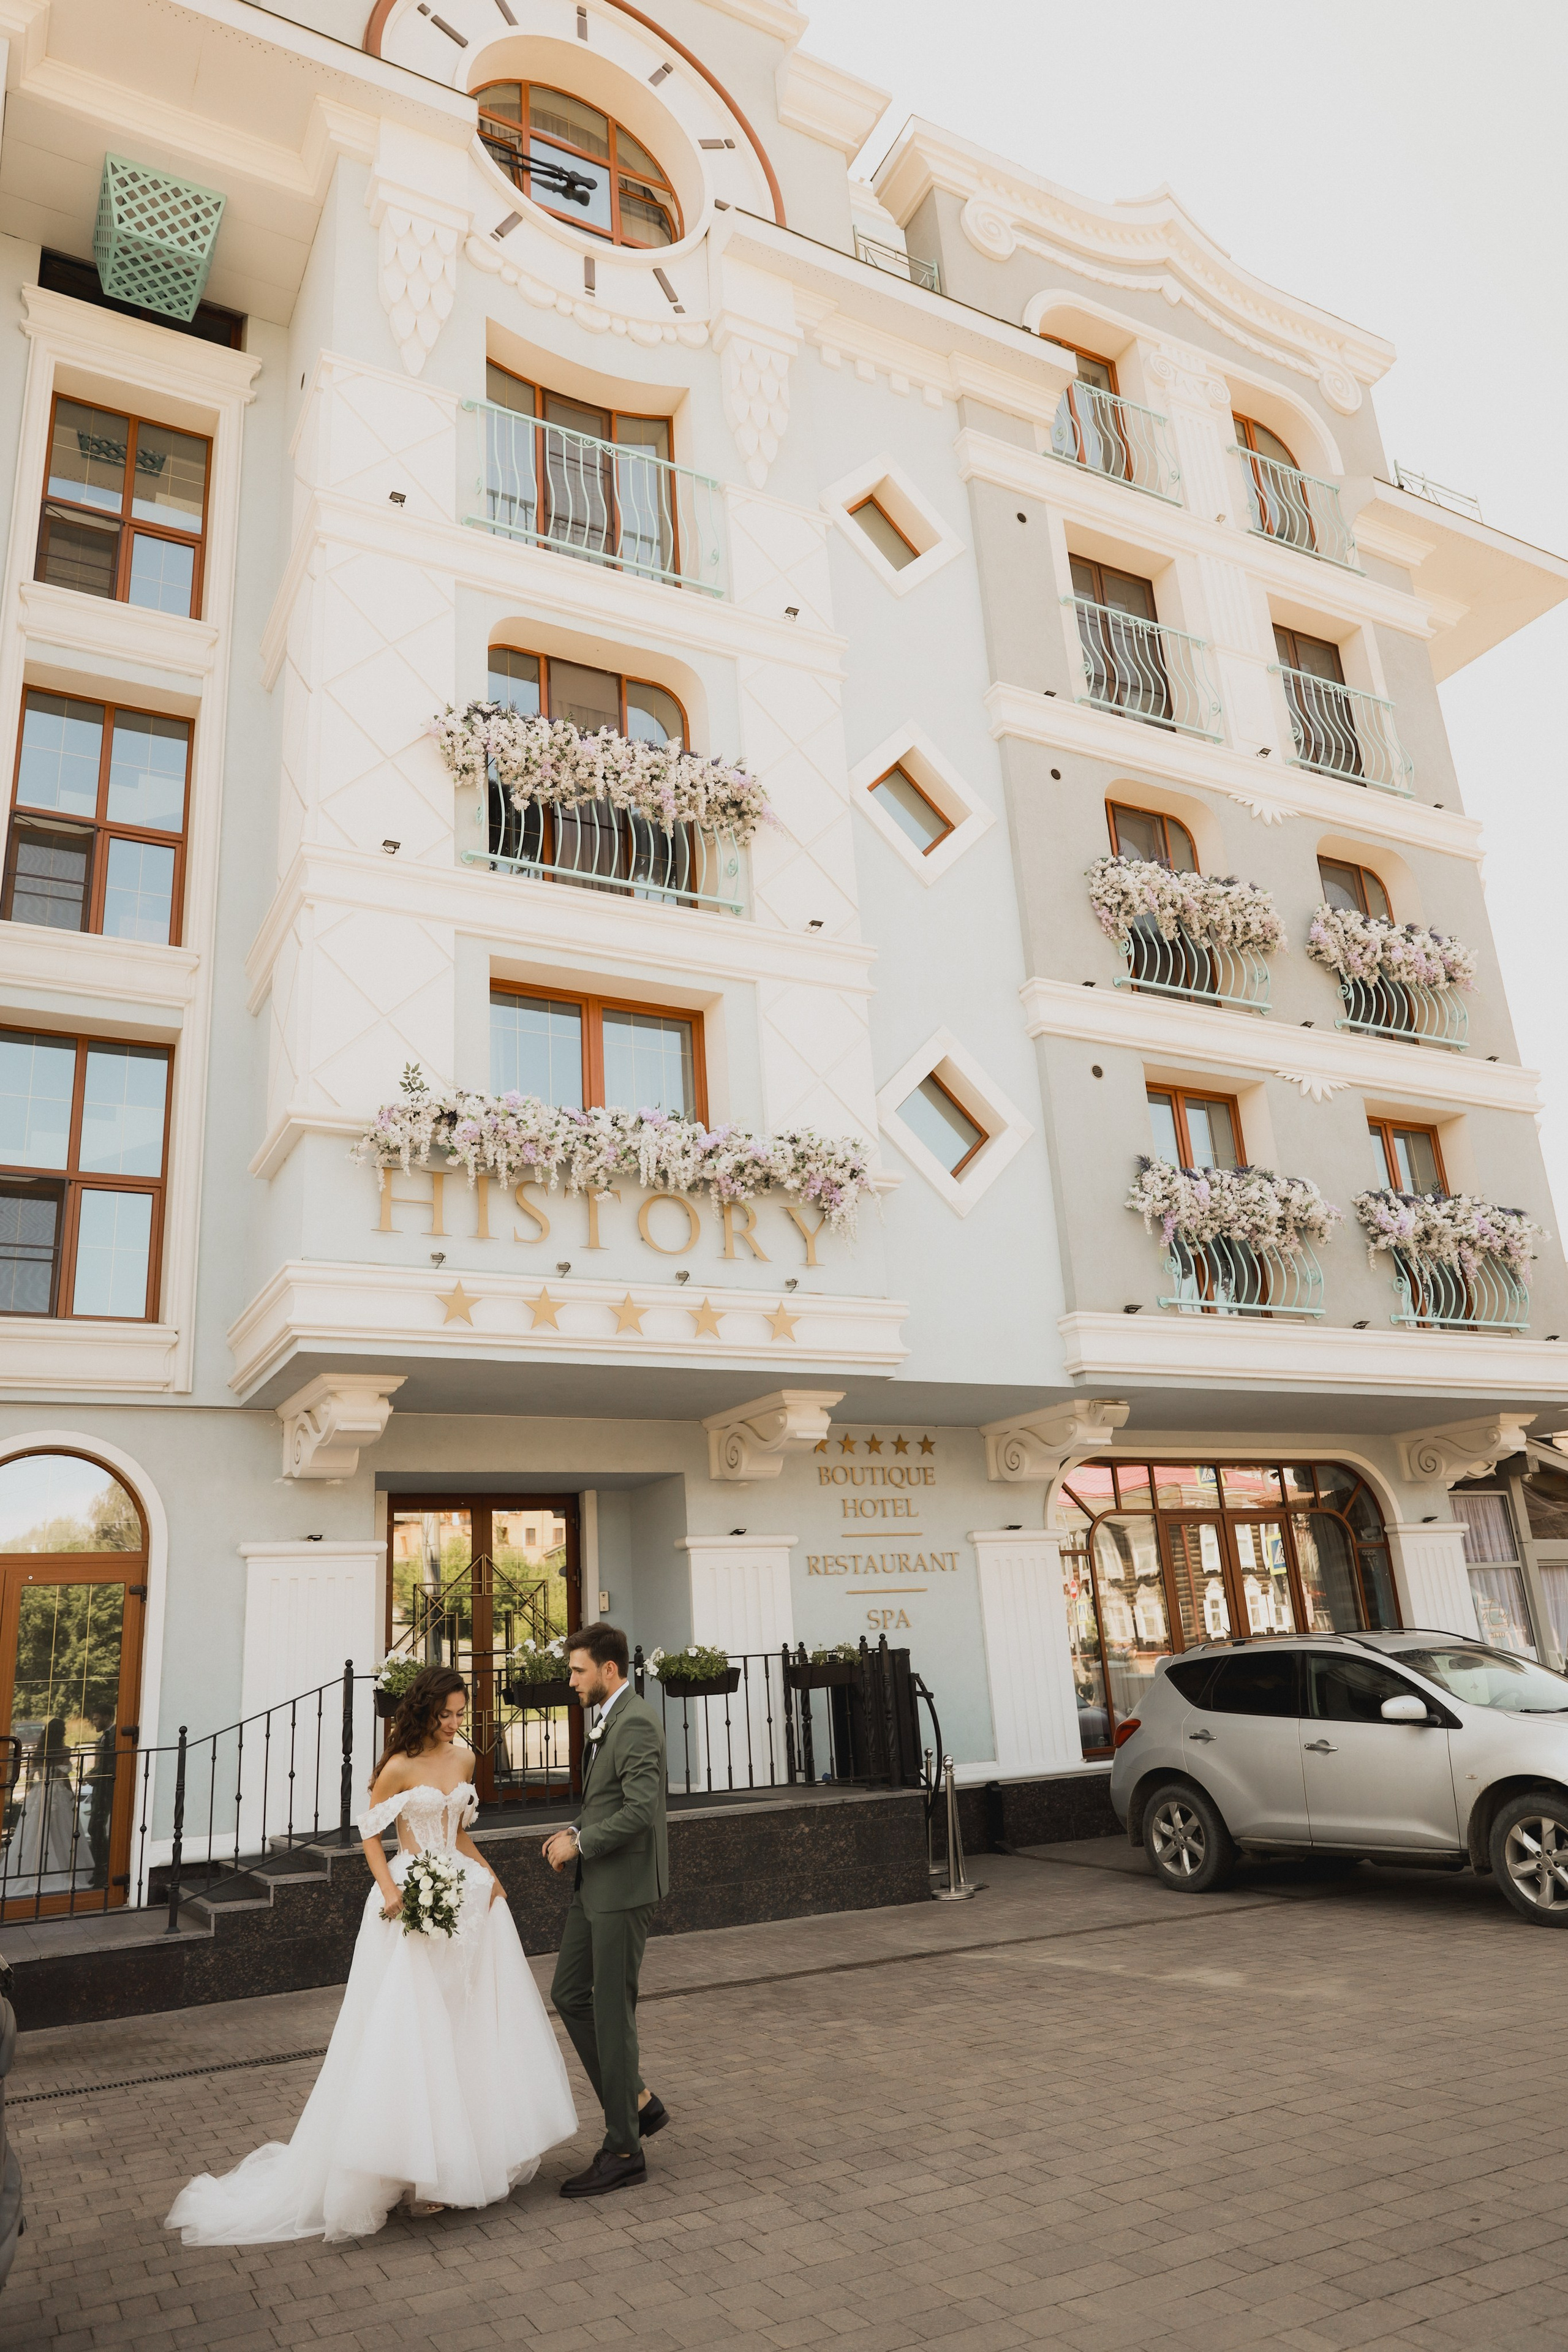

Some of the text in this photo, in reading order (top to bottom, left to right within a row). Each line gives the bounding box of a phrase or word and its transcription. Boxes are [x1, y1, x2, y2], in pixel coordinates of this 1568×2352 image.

[371, 1166, 827, 1266] HISTORY
[818, 1466, 936, 1489] BOUTIQUE
[842, 1498, 919, 1518] HOTEL
[807, 1551, 960, 1575] RESTAURANT
[867, 1608, 912, 1630] SPA
